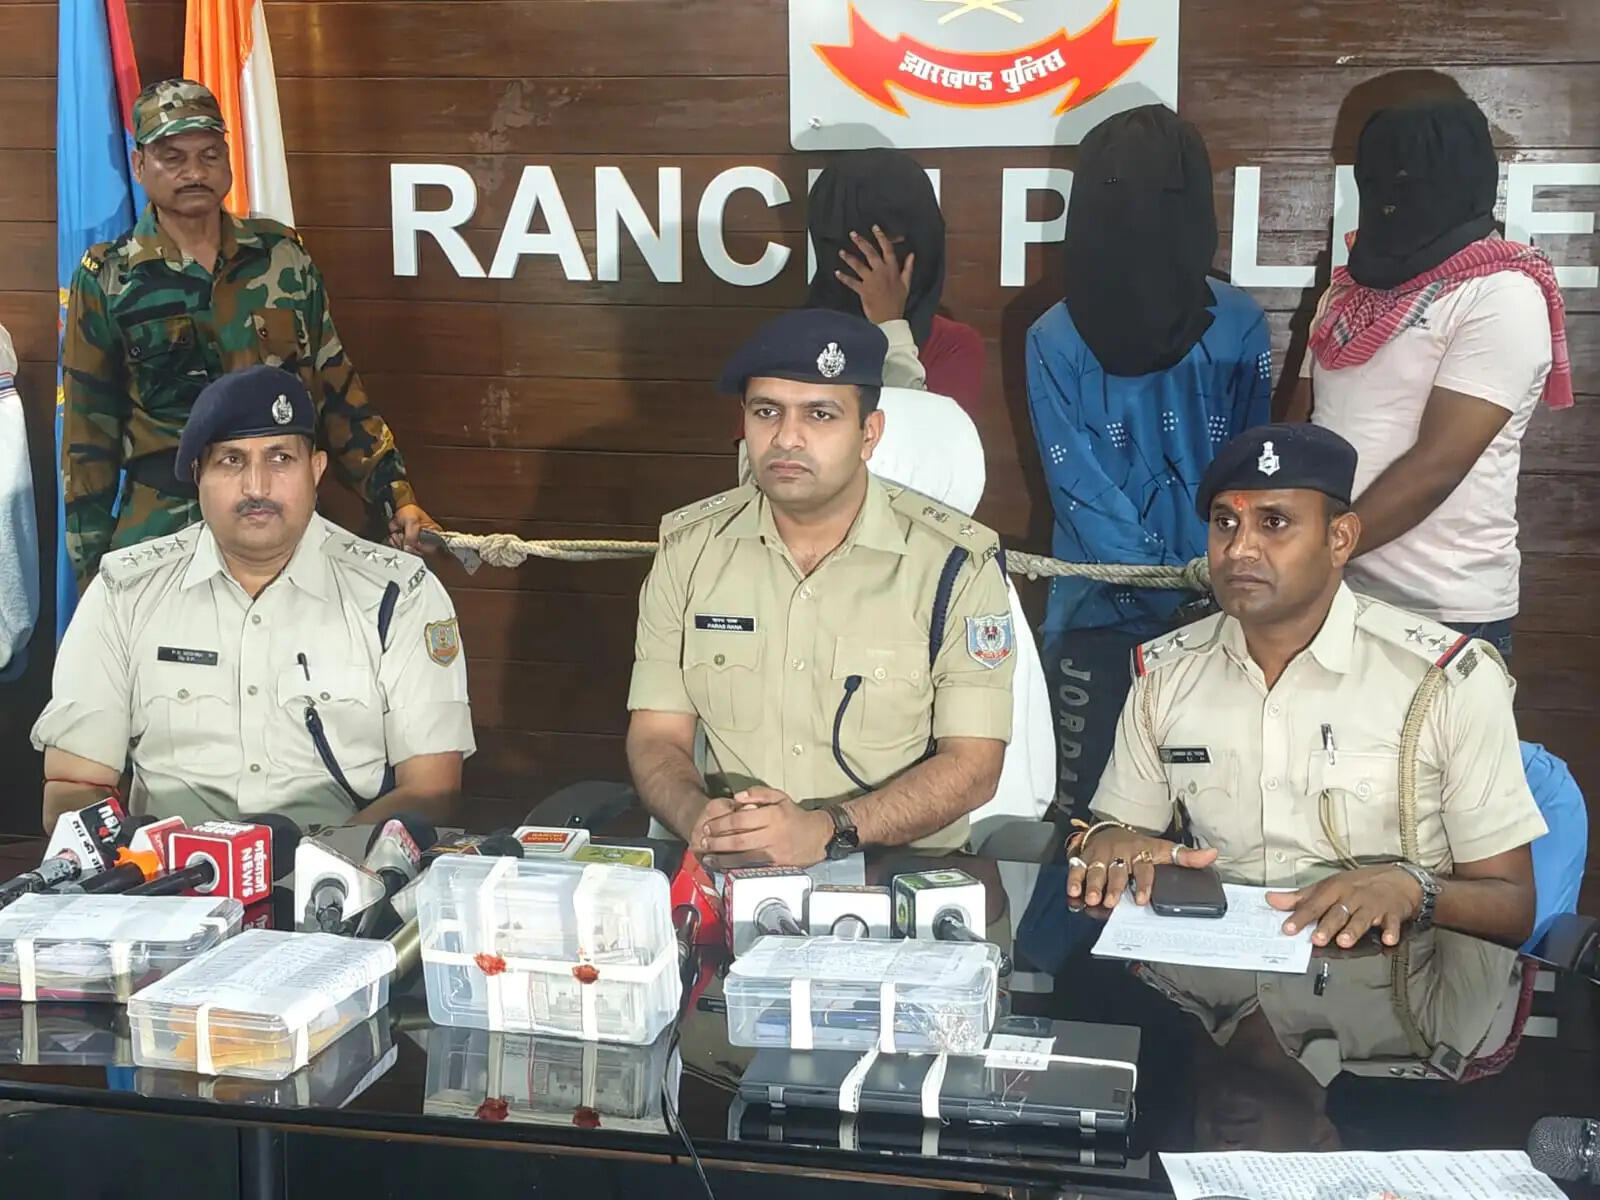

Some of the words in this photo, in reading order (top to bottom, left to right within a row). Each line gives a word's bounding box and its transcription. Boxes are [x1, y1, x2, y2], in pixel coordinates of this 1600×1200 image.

[899, 50, 993, 91] झारखण्ड
[1001, 49, 1066, 93] पुलिस
[390, 163, 941, 286] RANC
[1000, 163, 1600, 288] PLIE
[241, 847, 254, 898] NEWS
